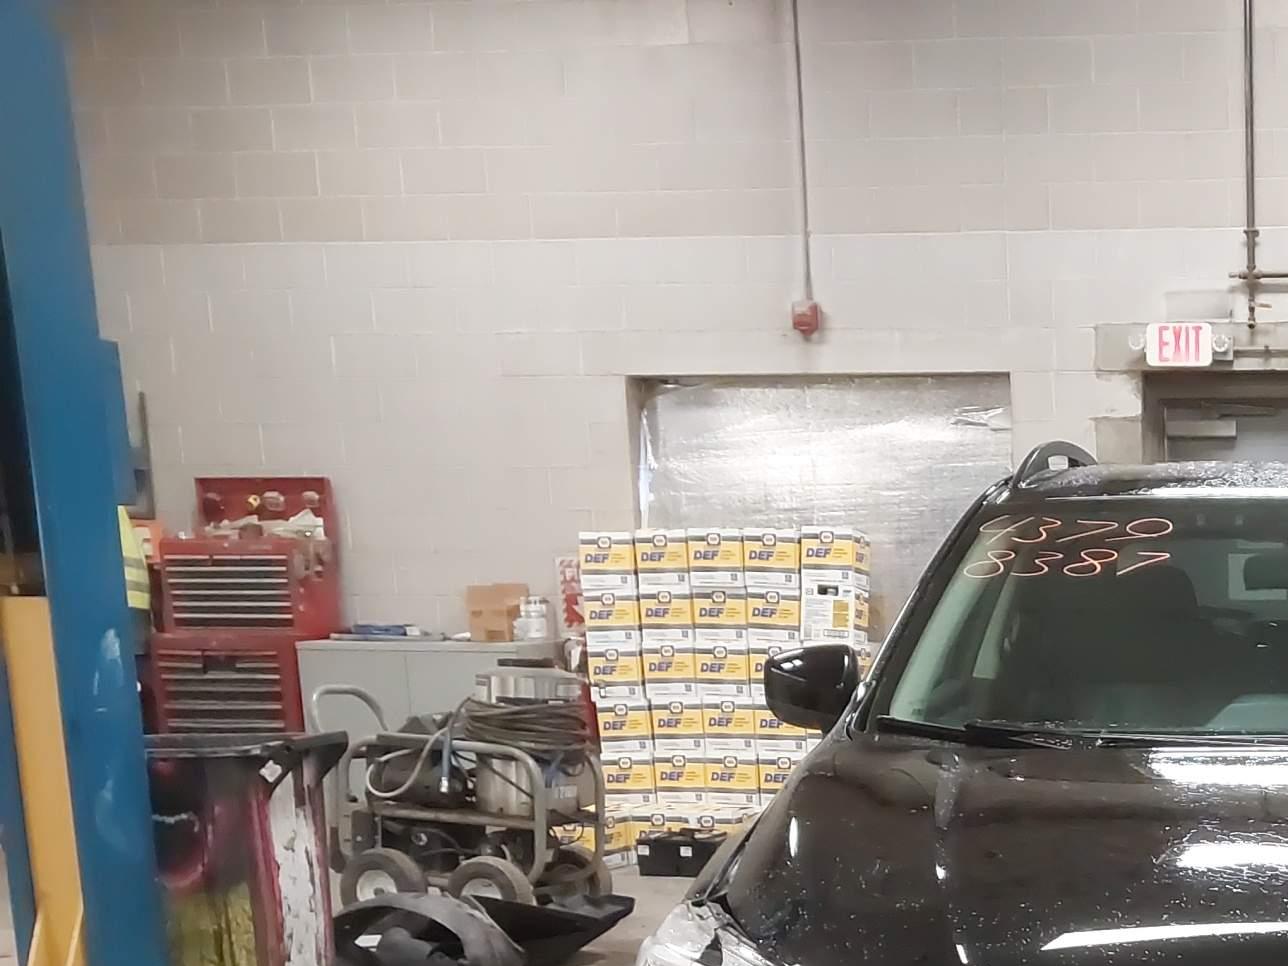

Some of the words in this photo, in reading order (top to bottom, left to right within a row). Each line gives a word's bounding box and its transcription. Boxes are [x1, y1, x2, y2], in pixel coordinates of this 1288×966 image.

[1158, 325, 1202, 362] EXIT
[641, 551, 665, 562] DEF
[694, 550, 719, 561] DEF
[748, 550, 775, 561] DEF
[806, 547, 832, 558] DEF
[585, 553, 609, 564] DEF
[963, 548, 1171, 578] 8387
[589, 609, 614, 620] DEF
[645, 607, 670, 618] DEF
[699, 607, 725, 618] DEF
[752, 607, 778, 618] DEF
[593, 664, 617, 675] DEF
[649, 661, 673, 672] DEF
[700, 662, 725, 673] DEF
[603, 719, 627, 731] DEF
[657, 716, 682, 728] DEF
[708, 716, 733, 728] DEF
[606, 773, 631, 784] DEF
[660, 770, 684, 781] DEF
[711, 771, 735, 782] DEF
